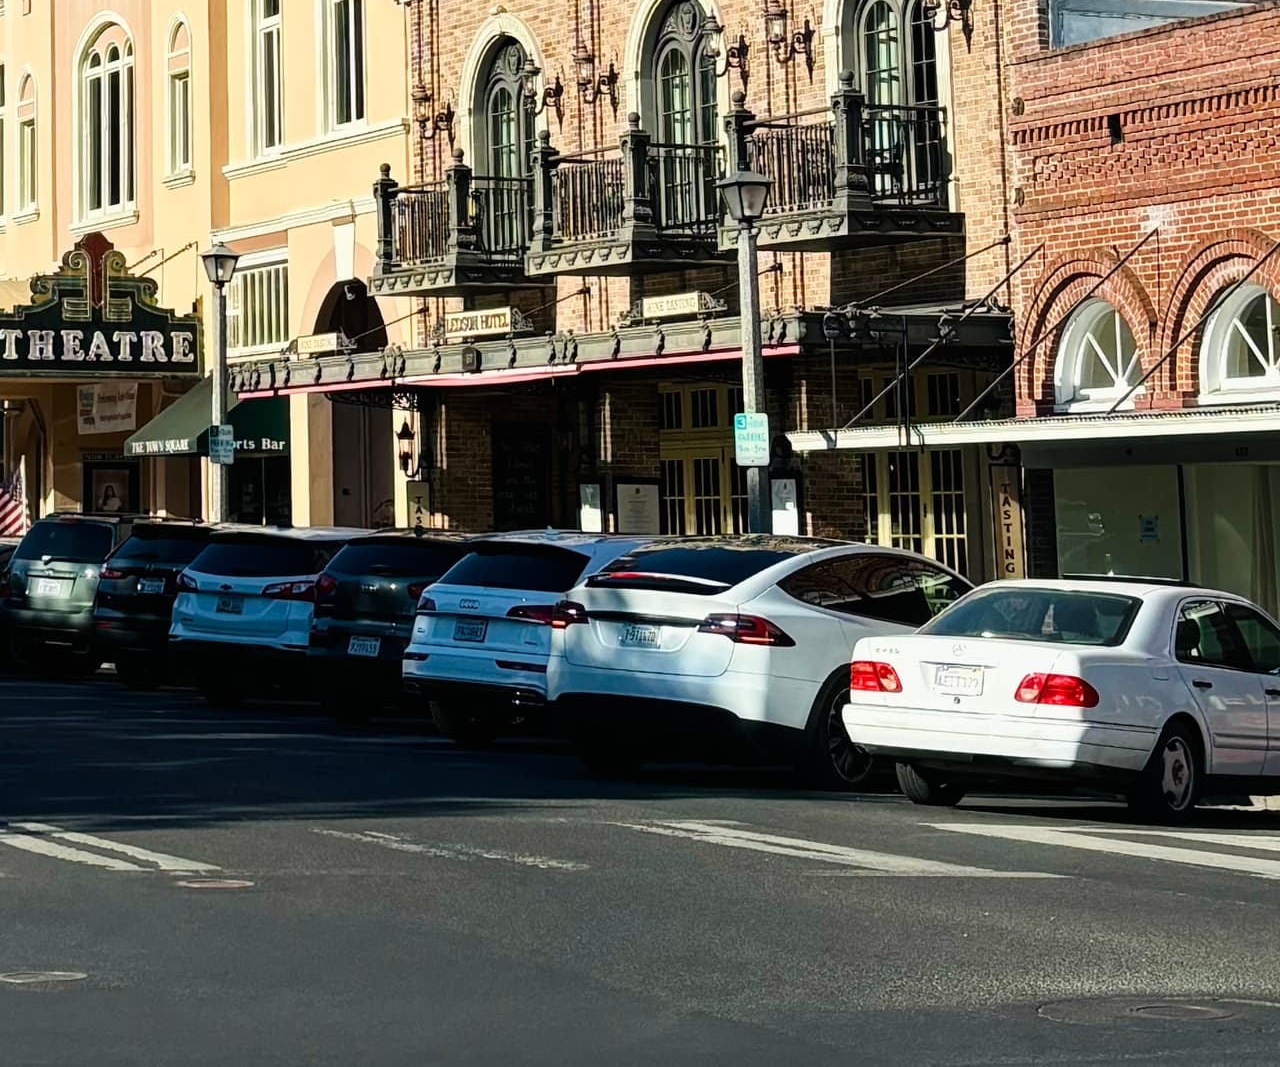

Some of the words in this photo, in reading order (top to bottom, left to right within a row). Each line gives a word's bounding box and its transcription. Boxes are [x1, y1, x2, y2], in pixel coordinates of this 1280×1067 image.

[446, 315, 478, 334] LEDSON
[480, 312, 509, 330] HOTEL
[131, 441, 144, 453] THE
[145, 440, 164, 453] TOWN
[165, 439, 190, 453] SQUARE
[261, 438, 286, 450] Bar
[1000, 483, 1016, 574] TASTING
